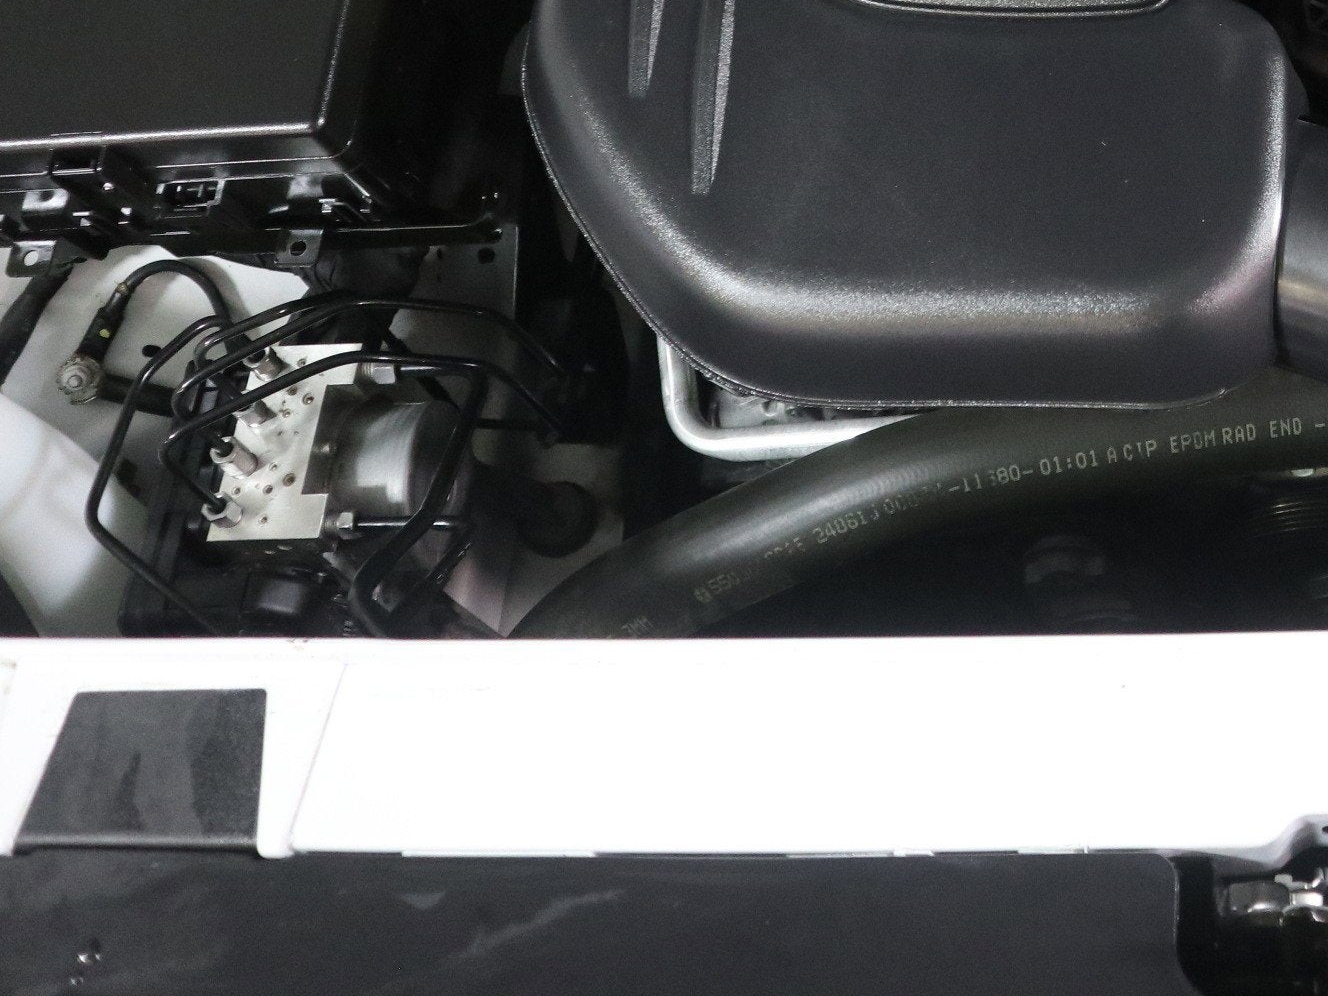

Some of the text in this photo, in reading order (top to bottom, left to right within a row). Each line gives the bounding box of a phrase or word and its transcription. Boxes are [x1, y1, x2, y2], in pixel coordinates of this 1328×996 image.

[1169, 428, 1217, 455] EPDM
[1221, 422, 1256, 446] RAD
[1269, 416, 1303, 440] END
